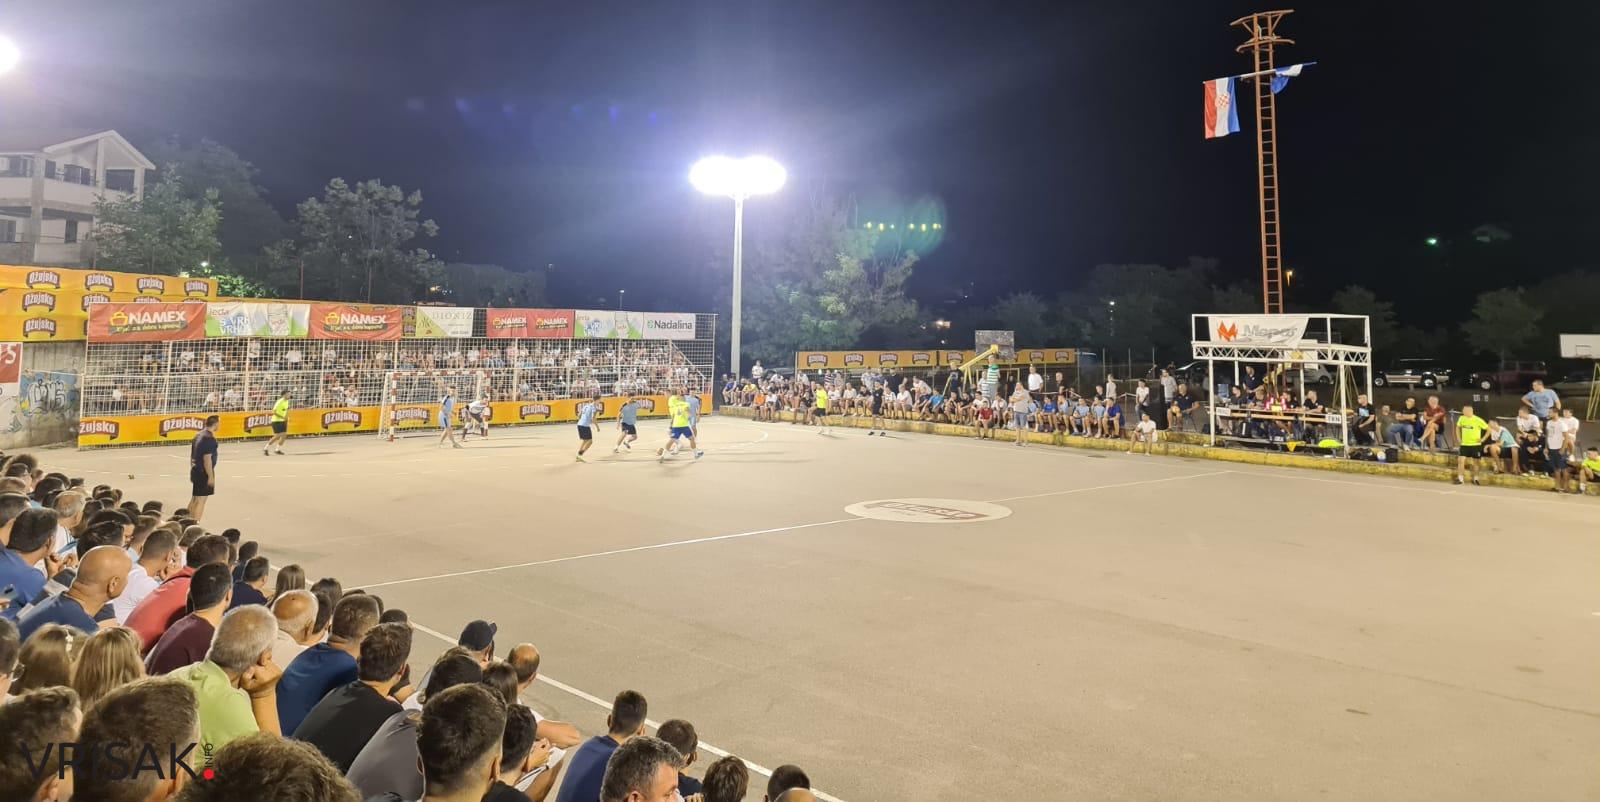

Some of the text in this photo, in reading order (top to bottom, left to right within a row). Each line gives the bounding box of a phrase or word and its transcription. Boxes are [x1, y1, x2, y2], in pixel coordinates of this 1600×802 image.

[128, 311, 186, 325] NAMEX
[340, 314, 386, 324] NAMEX
[654, 320, 693, 330] Nadalina
[163, 417, 204, 431] Ožujsko
